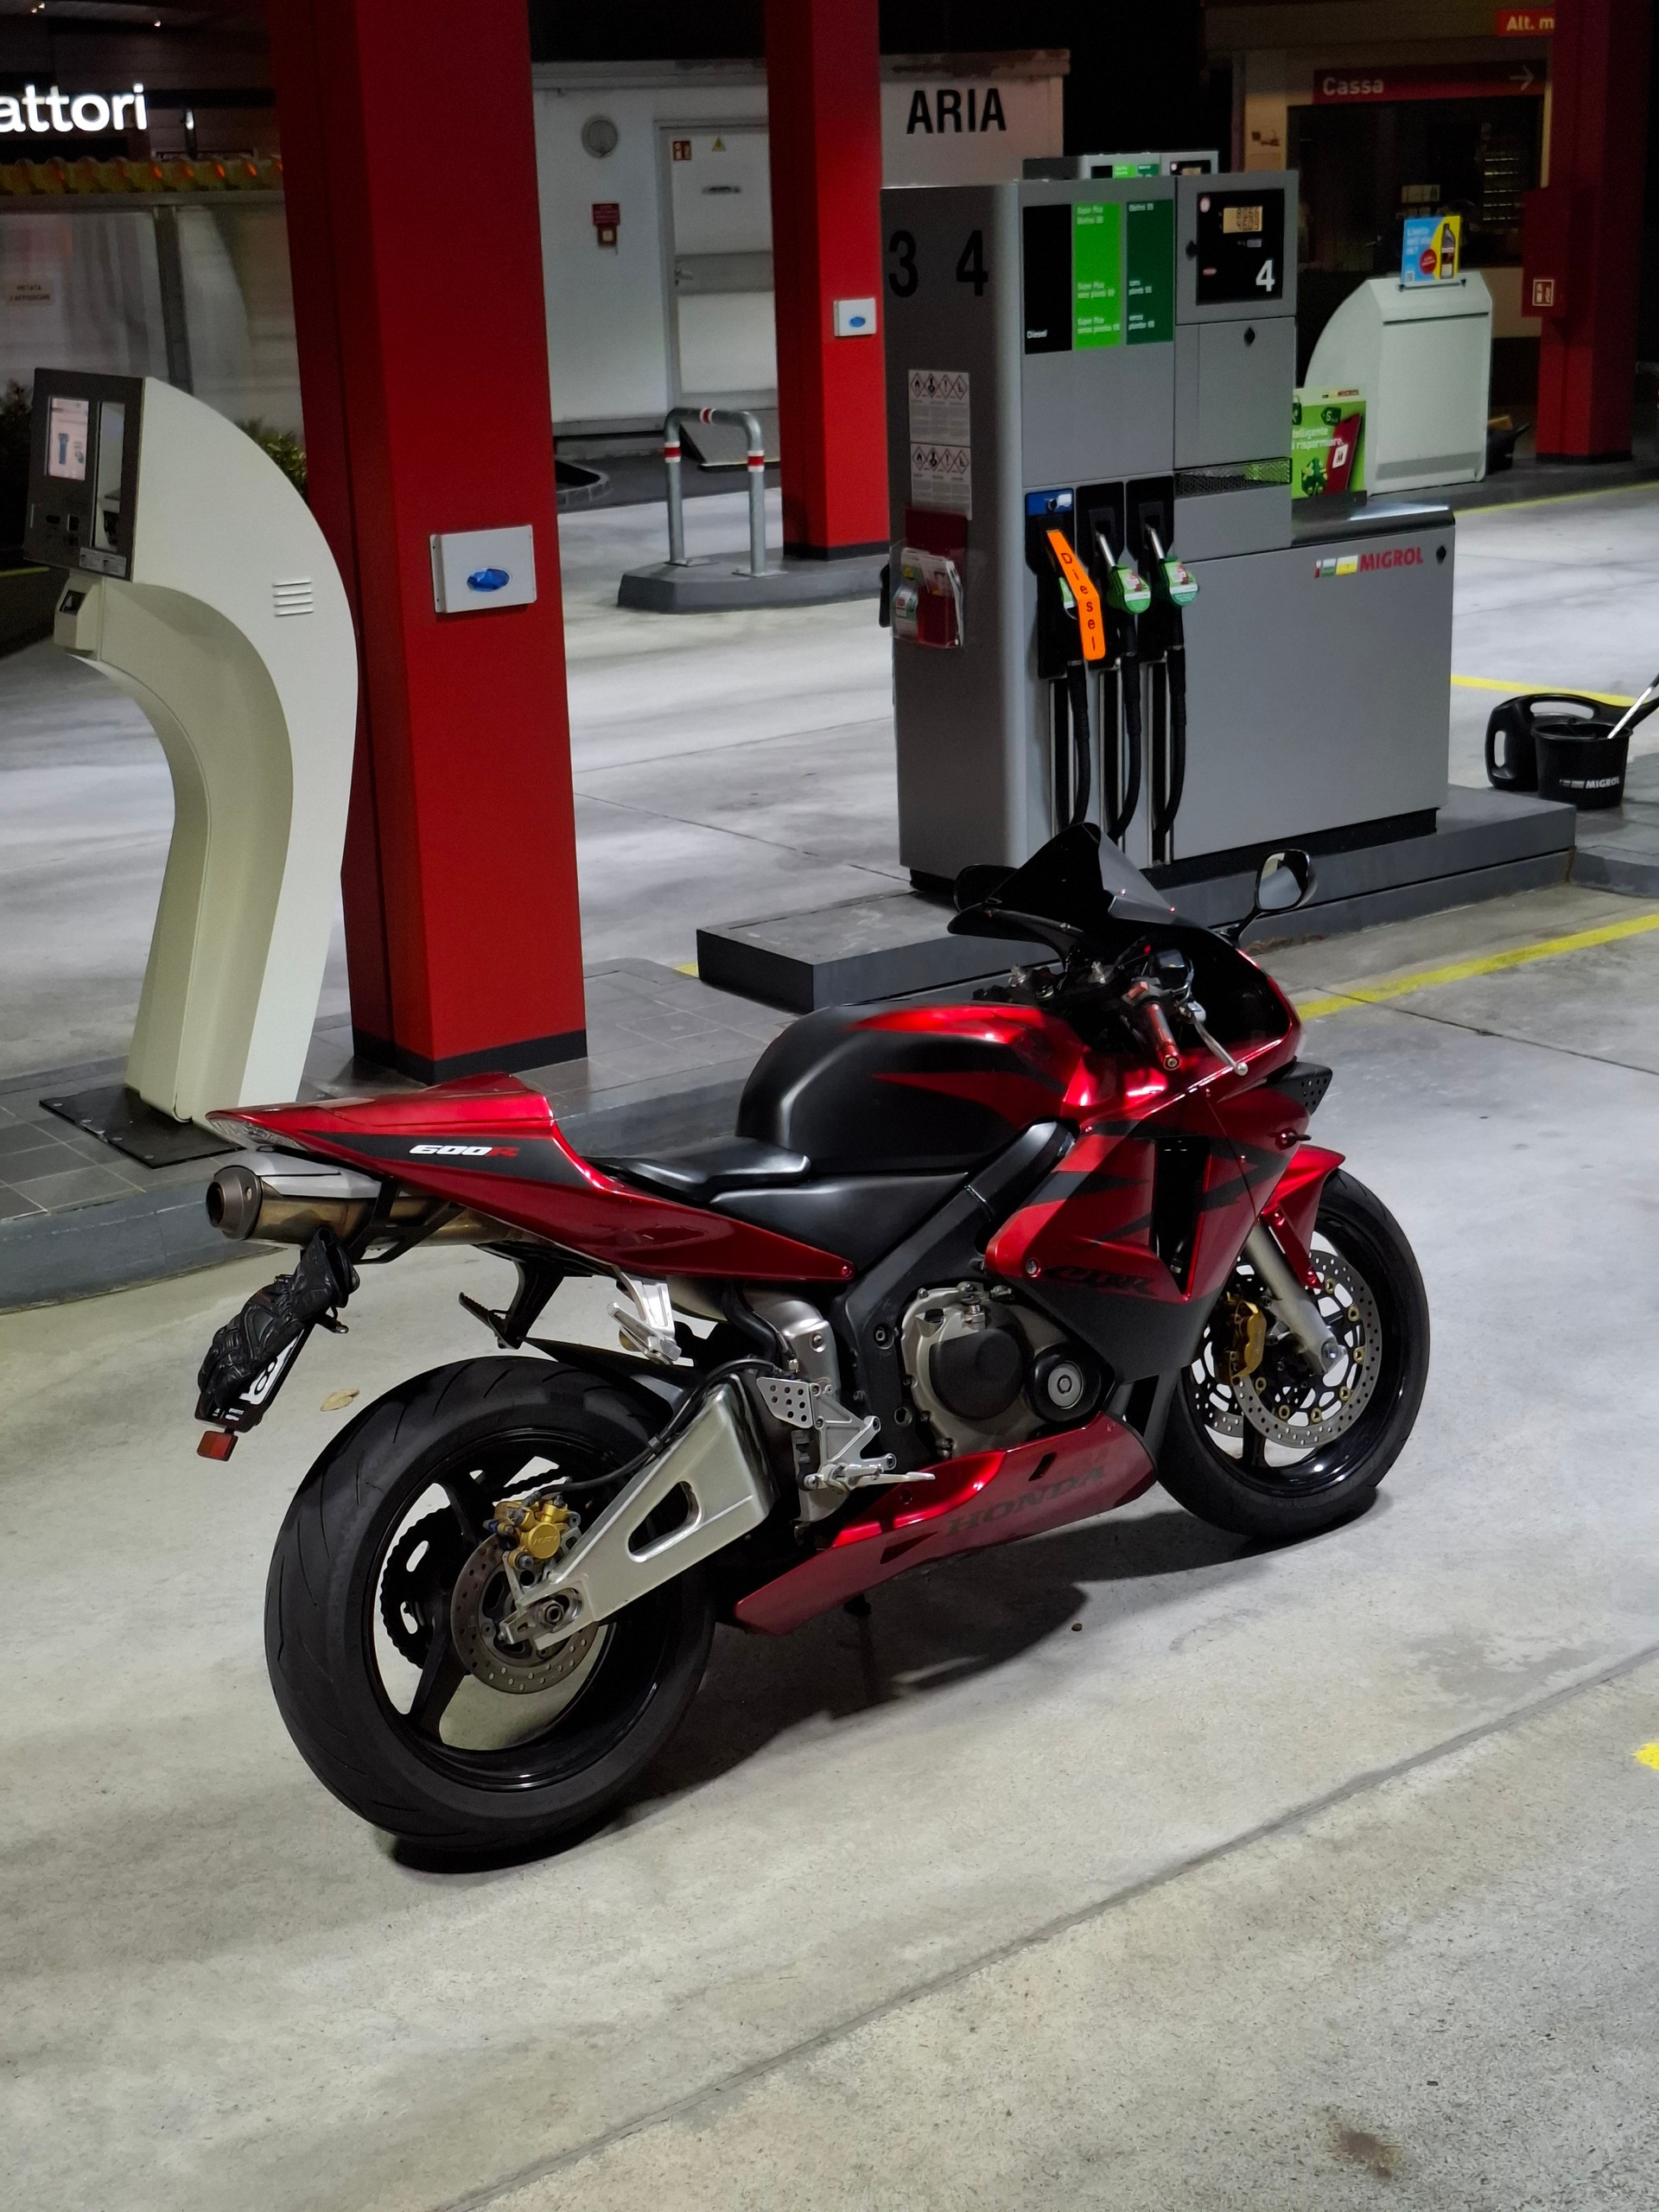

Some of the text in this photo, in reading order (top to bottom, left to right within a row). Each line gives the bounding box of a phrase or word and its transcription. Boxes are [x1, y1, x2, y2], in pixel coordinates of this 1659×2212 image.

[0, 83, 148, 132] attori
[1323, 76, 1384, 96] Cassa
[906, 87, 1007, 134] ARIA
[888, 230, 988, 298] 3 4
[1255, 259, 1276, 292] 4
[1359, 547, 1424, 572] MIGROL
[1060, 552, 1096, 651] Diesel
[410, 1145, 519, 1158] 600R
[945, 1465, 1107, 1535] HONDA
